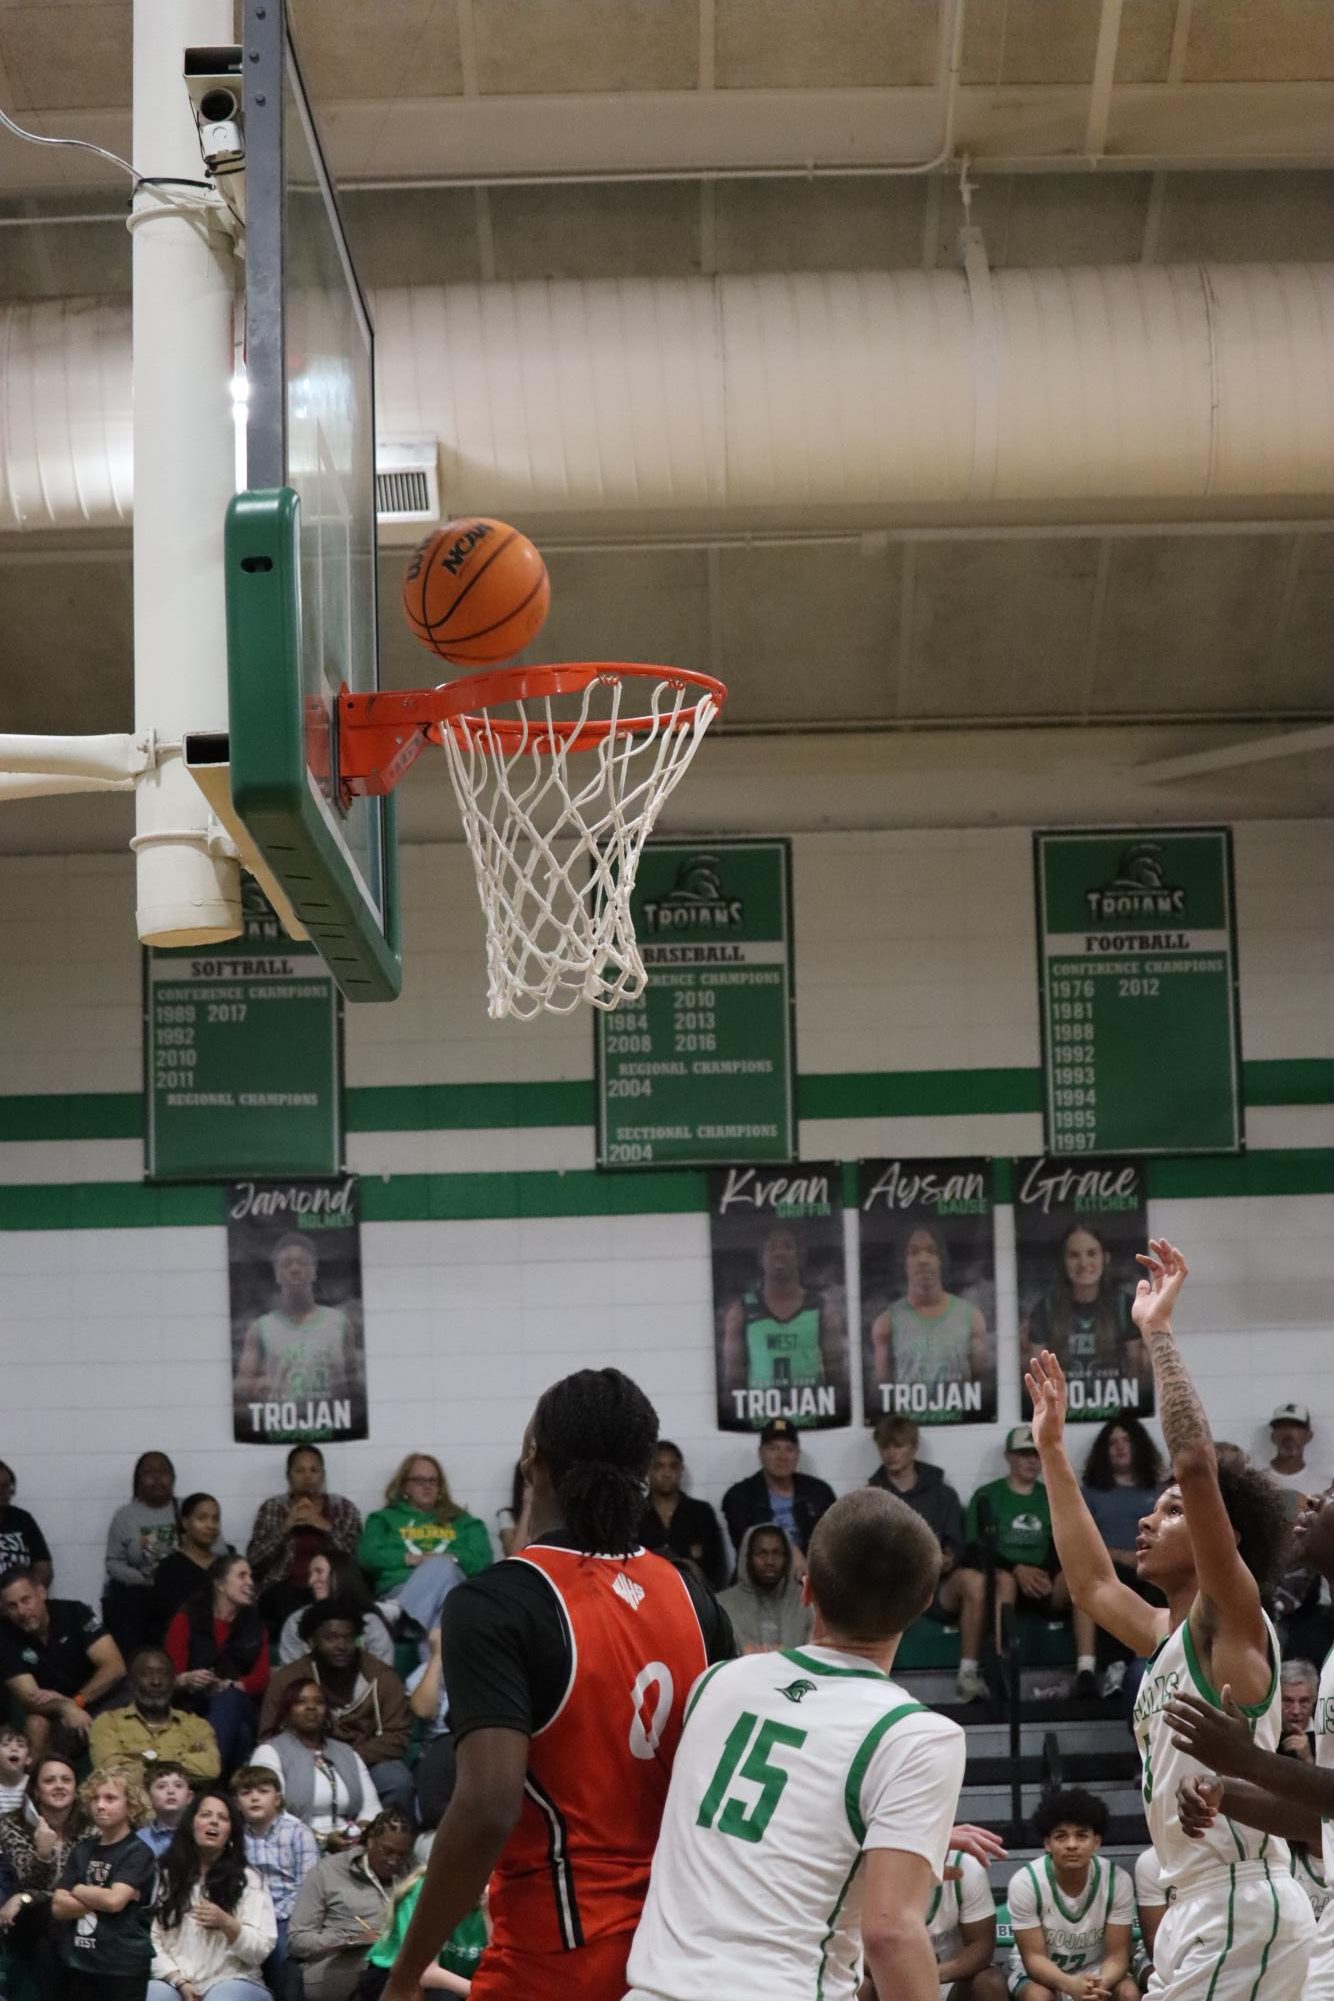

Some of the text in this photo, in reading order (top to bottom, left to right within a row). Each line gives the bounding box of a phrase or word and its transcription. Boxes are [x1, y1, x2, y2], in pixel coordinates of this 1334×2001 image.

[441, 523, 494, 576] NCAA
[1087, 890, 1184, 919] TROJANS
[644, 902, 743, 930] TROJANS
[1086, 934, 1189, 951] FOOTBALL
[643, 946, 745, 962] BASEBALL
[191, 959, 293, 979] SOFTBALL
[1053, 959, 1223, 976] CONFERENCE CHAMPIONS
[701, 972, 780, 984] CHAMPIONS
[157, 985, 328, 1001] CONFERENCE CHAMPIONS
[1052, 979, 1160, 998] 1976 2012
[673, 990, 716, 1008] 2010
[207, 1004, 248, 1022] 2017
[1053, 1002, 1093, 1019] 1981
[607, 1012, 716, 1031] 1984 2013
[156, 1028, 195, 1045] 1992
[608, 1034, 717, 1053] 2008 2016
[156, 1049, 197, 1068] 2010
[1054, 1045, 1095, 1063] 1992
[619, 1060, 773, 1076] REGIONAL CHAMPIONS
[1054, 1067, 1096, 1085] 1993
[156, 1071, 194, 1089] 2011
[608, 1079, 653, 1098] 2004
[167, 1092, 318, 1106] REGIONAL CHAMPIONS
[1055, 1089, 1097, 1107] 1994
[1056, 1110, 1097, 1128] 1995
[617, 1125, 778, 1141] SECTIONAL CHAMPIONS
[1056, 1132, 1097, 1150] 1997
[609, 1144, 653, 1162] 2004
[1020, 1159, 1138, 1214] Grace
[231, 1178, 354, 1219] Jamond
[731, 1386, 836, 1419] TROJAN
[878, 1382, 981, 1412] TROJAN
[1065, 1378, 1139, 1409] OJAN
[248, 1400, 352, 1431] TROJAN
[628, 1661, 673, 1761] 0
[695, 1711, 808, 1844] 15
[1046, 1928, 1105, 1950] ROJANS
